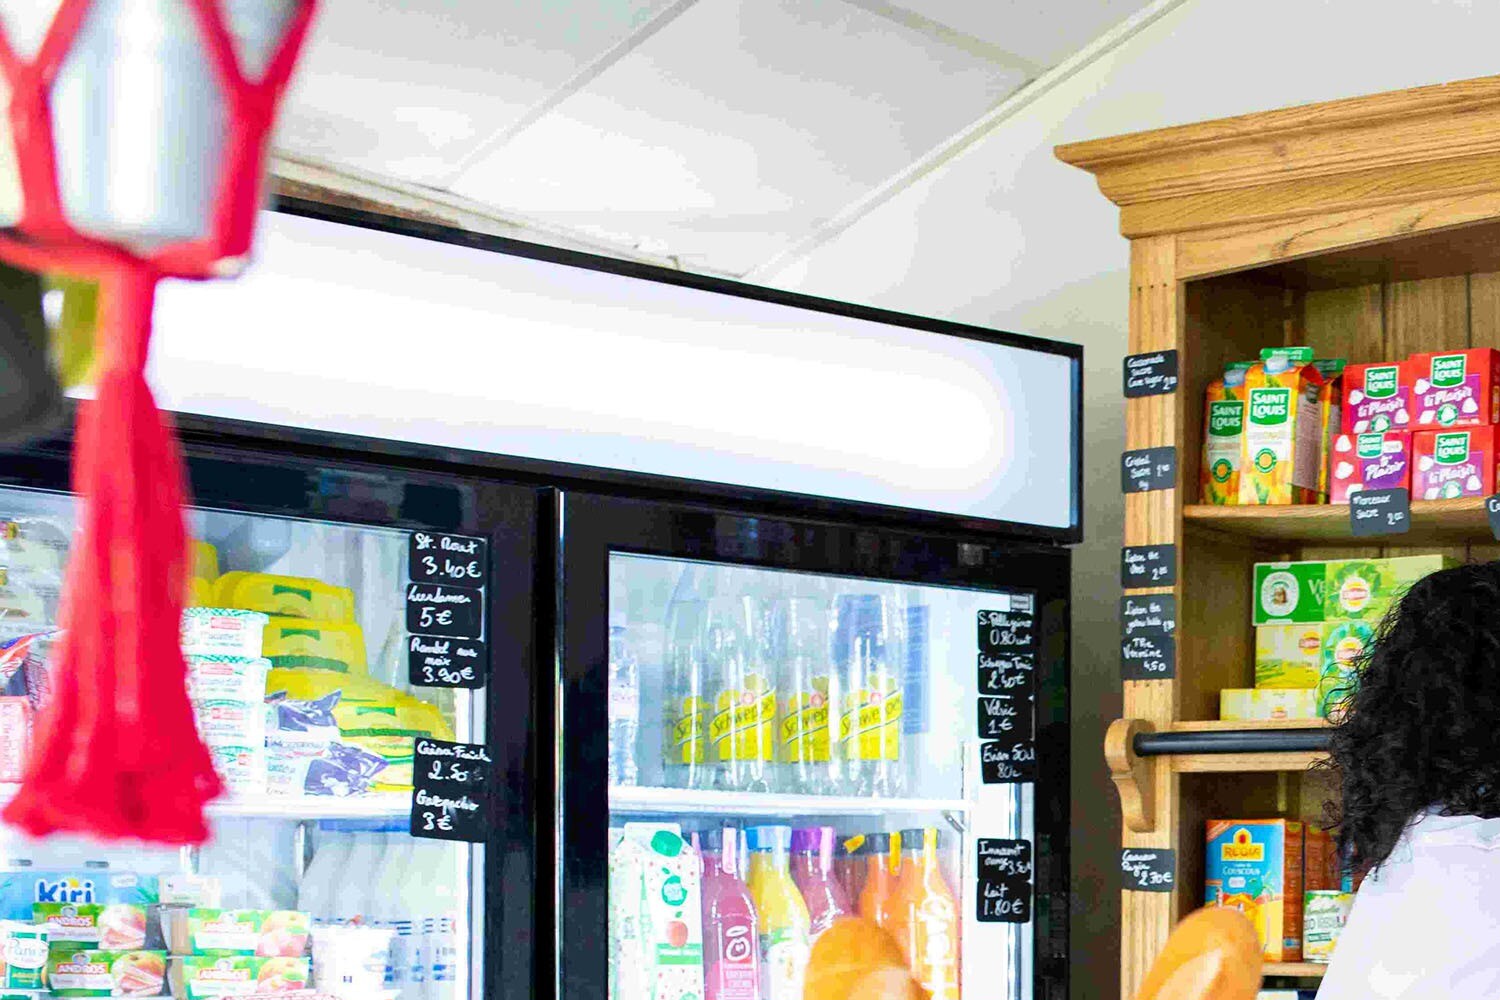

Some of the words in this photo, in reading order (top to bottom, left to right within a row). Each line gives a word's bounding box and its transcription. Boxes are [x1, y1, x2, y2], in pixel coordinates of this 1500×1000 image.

[1253, 391, 1287, 404] SAINT
[1212, 405, 1241, 417] SAINT
[1252, 403, 1287, 418] LOUIS
[1211, 417, 1241, 431] LOUIS
[419, 607, 453, 629] 5€
[988, 719, 1013, 734] 1€
[423, 812, 453, 831] 3€
